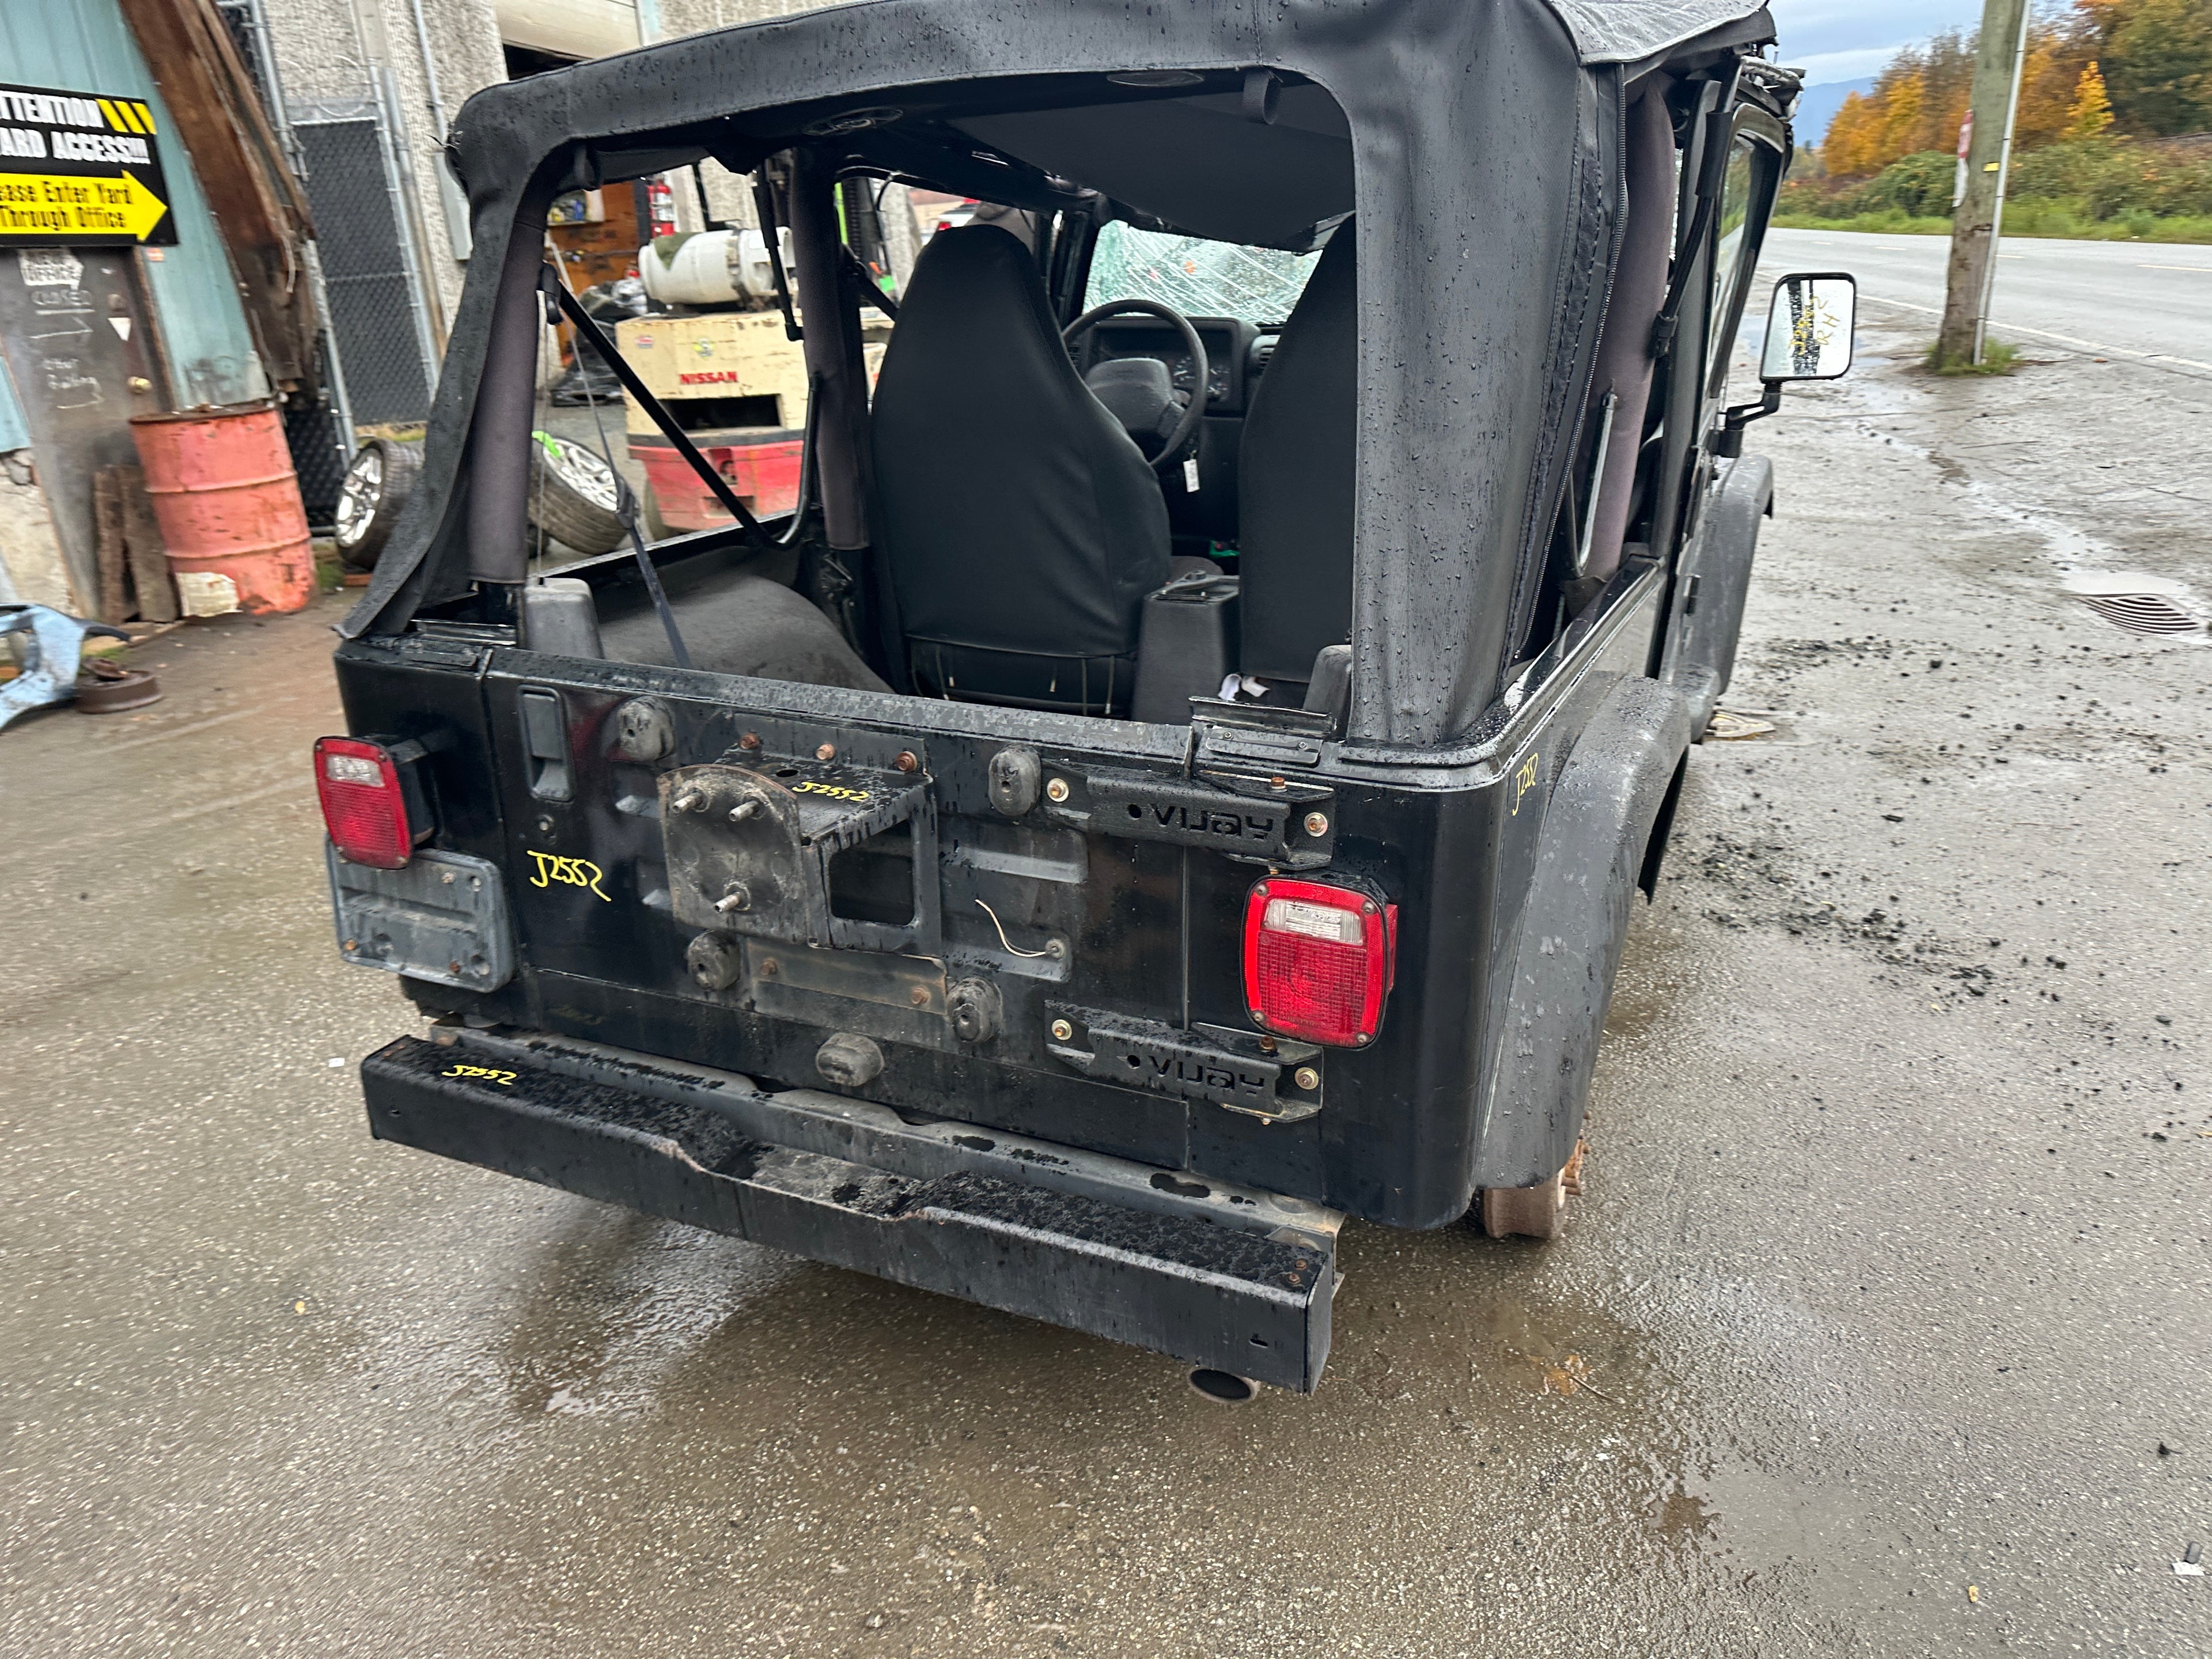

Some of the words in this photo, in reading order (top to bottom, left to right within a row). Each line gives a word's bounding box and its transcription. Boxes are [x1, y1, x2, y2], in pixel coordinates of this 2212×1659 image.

[0, 90, 104, 127] TTENTION
[0, 127, 46, 158] ARD
[0, 184, 37, 202] ease
[40, 180, 90, 203] Enter
[0, 204, 71, 230] Through
[75, 206, 127, 227] Office
[680, 372, 738, 384] NISSAN
[792, 781, 869, 801] J2552
[527, 850, 611, 902] J2552
[441, 1065, 517, 1085] J2552
